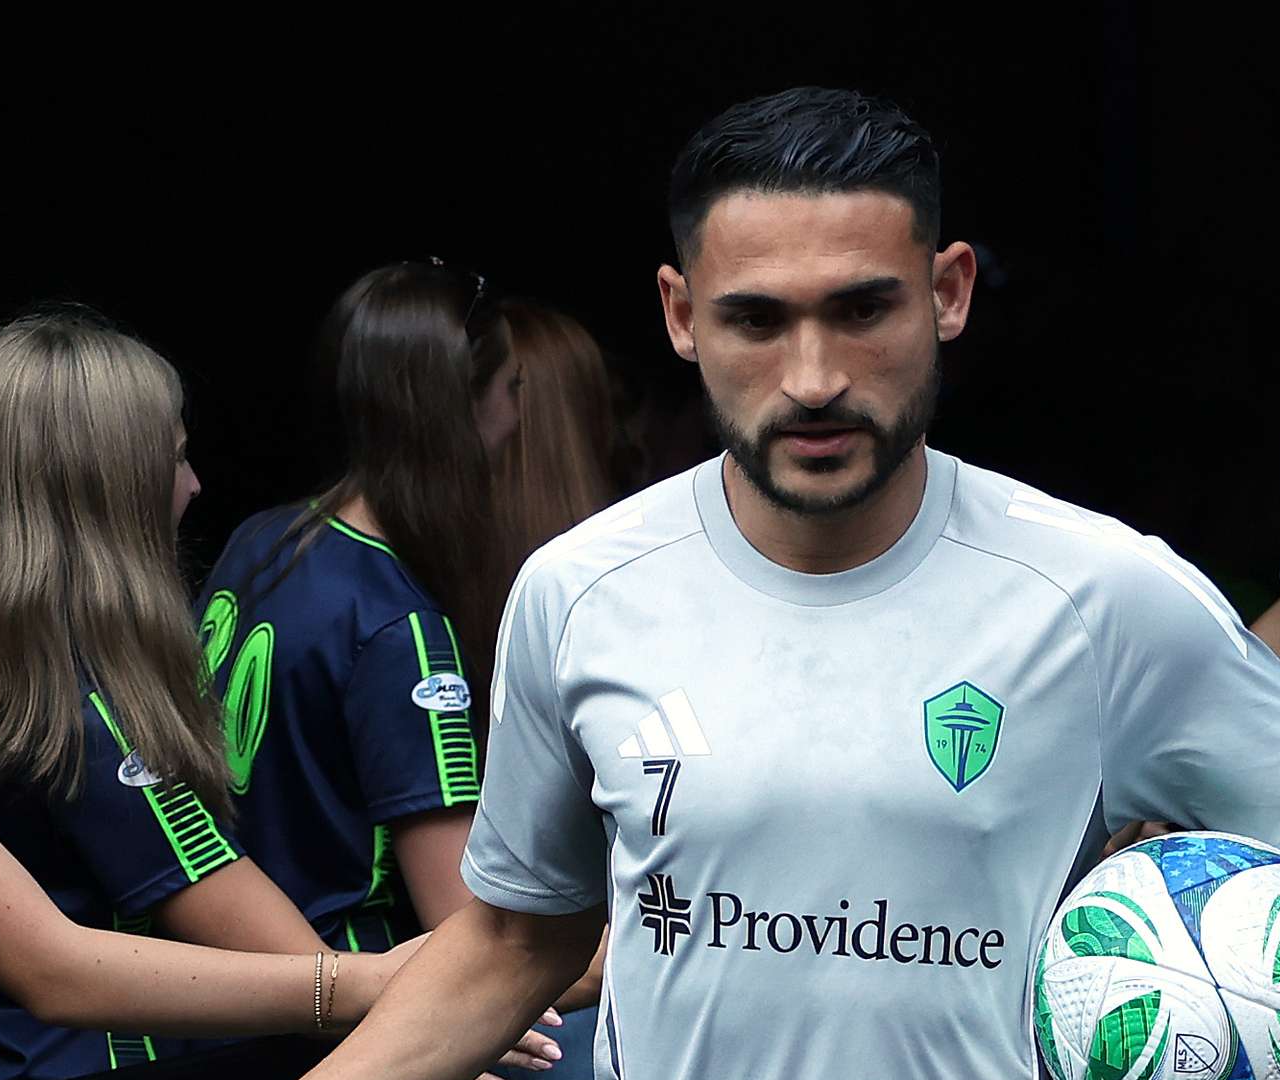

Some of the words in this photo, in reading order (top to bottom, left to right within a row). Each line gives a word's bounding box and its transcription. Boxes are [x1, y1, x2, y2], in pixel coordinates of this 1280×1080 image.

[936, 739, 948, 749] 19
[975, 743, 986, 753] 74
[642, 758, 680, 836] 7
[706, 892, 1005, 970] Providence
[1177, 1049, 1187, 1070] MLS
